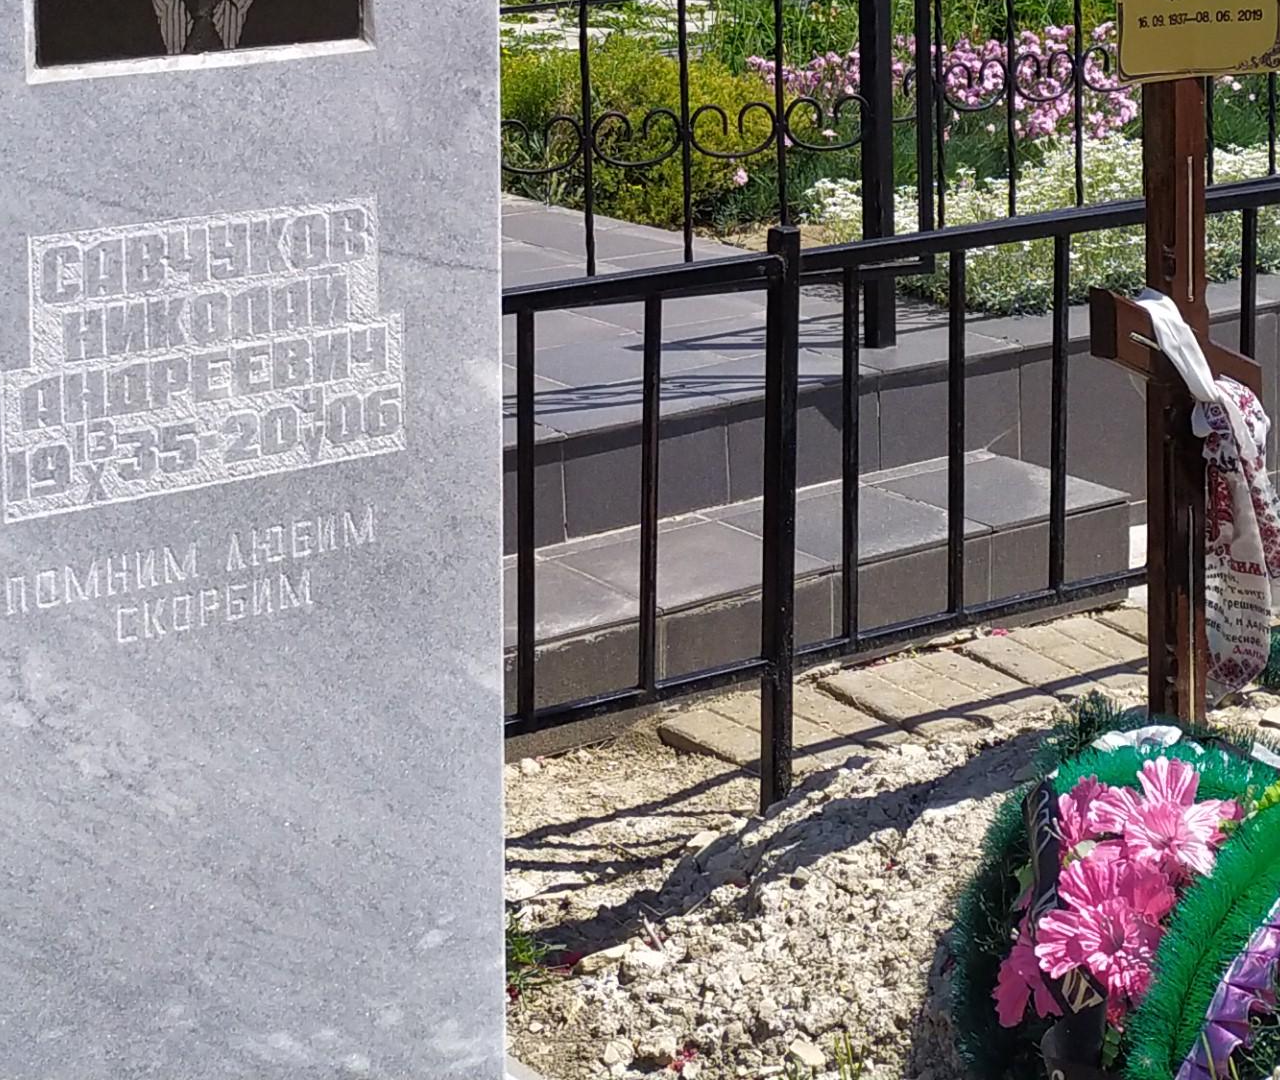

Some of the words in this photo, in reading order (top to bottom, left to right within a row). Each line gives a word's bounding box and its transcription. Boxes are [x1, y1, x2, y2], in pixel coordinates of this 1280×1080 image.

[1237, 9, 1263, 21] 2019
[41, 206, 369, 307] САВЧУКОВ
[22, 326, 388, 432] АНДРЕЕВИЧ
[5, 542, 198, 616] ПОМНИМ
[225, 503, 377, 573] ЛЮБИМ
[116, 568, 315, 644] СКОРБИМ
